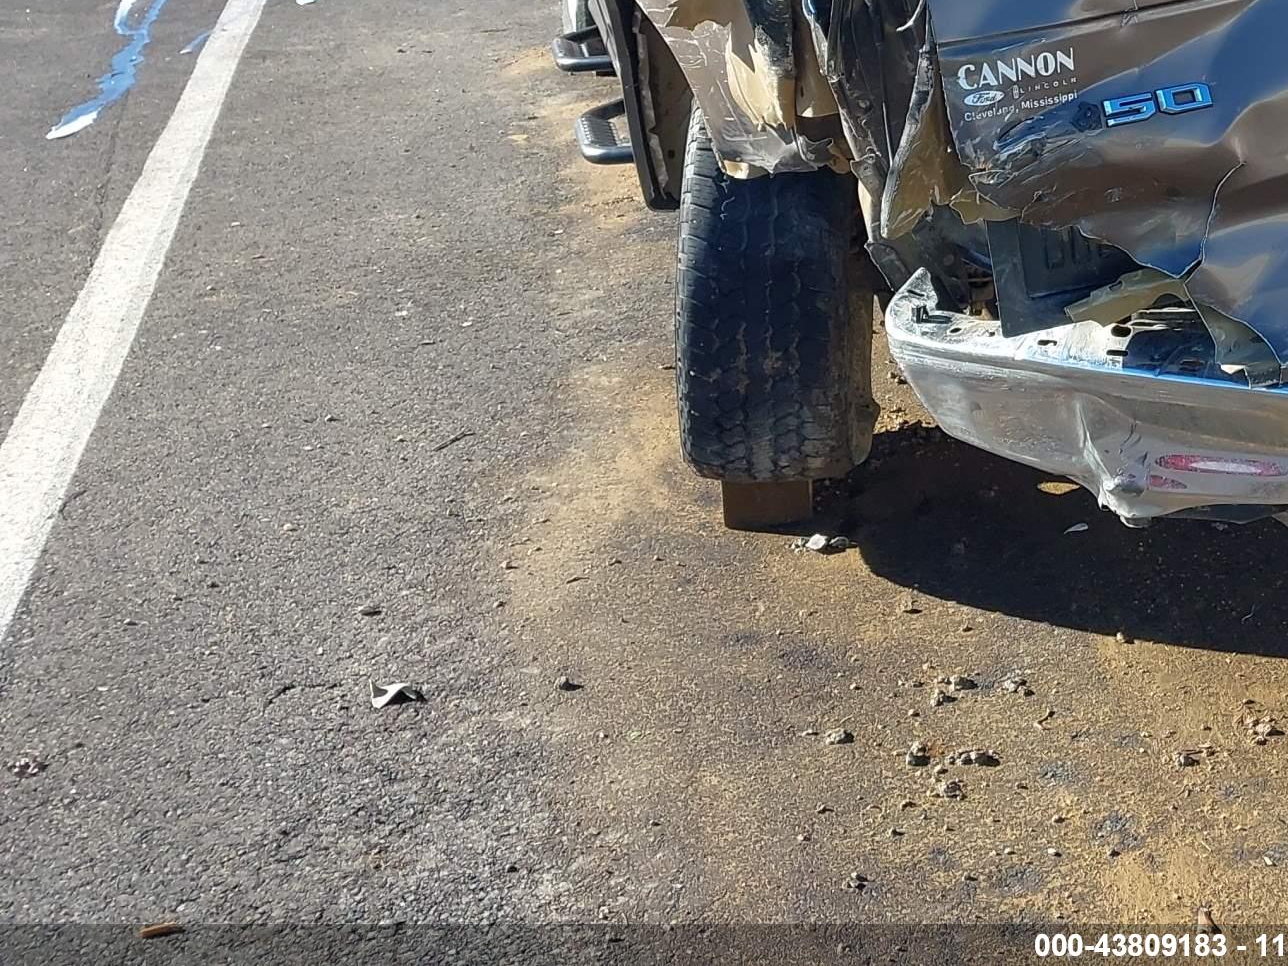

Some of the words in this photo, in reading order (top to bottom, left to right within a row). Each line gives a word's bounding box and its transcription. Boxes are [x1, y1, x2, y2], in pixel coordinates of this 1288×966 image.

[957, 47, 1075, 90] CANNON
[969, 91, 998, 104] Ford
[1021, 90, 1078, 109] Mississippi
